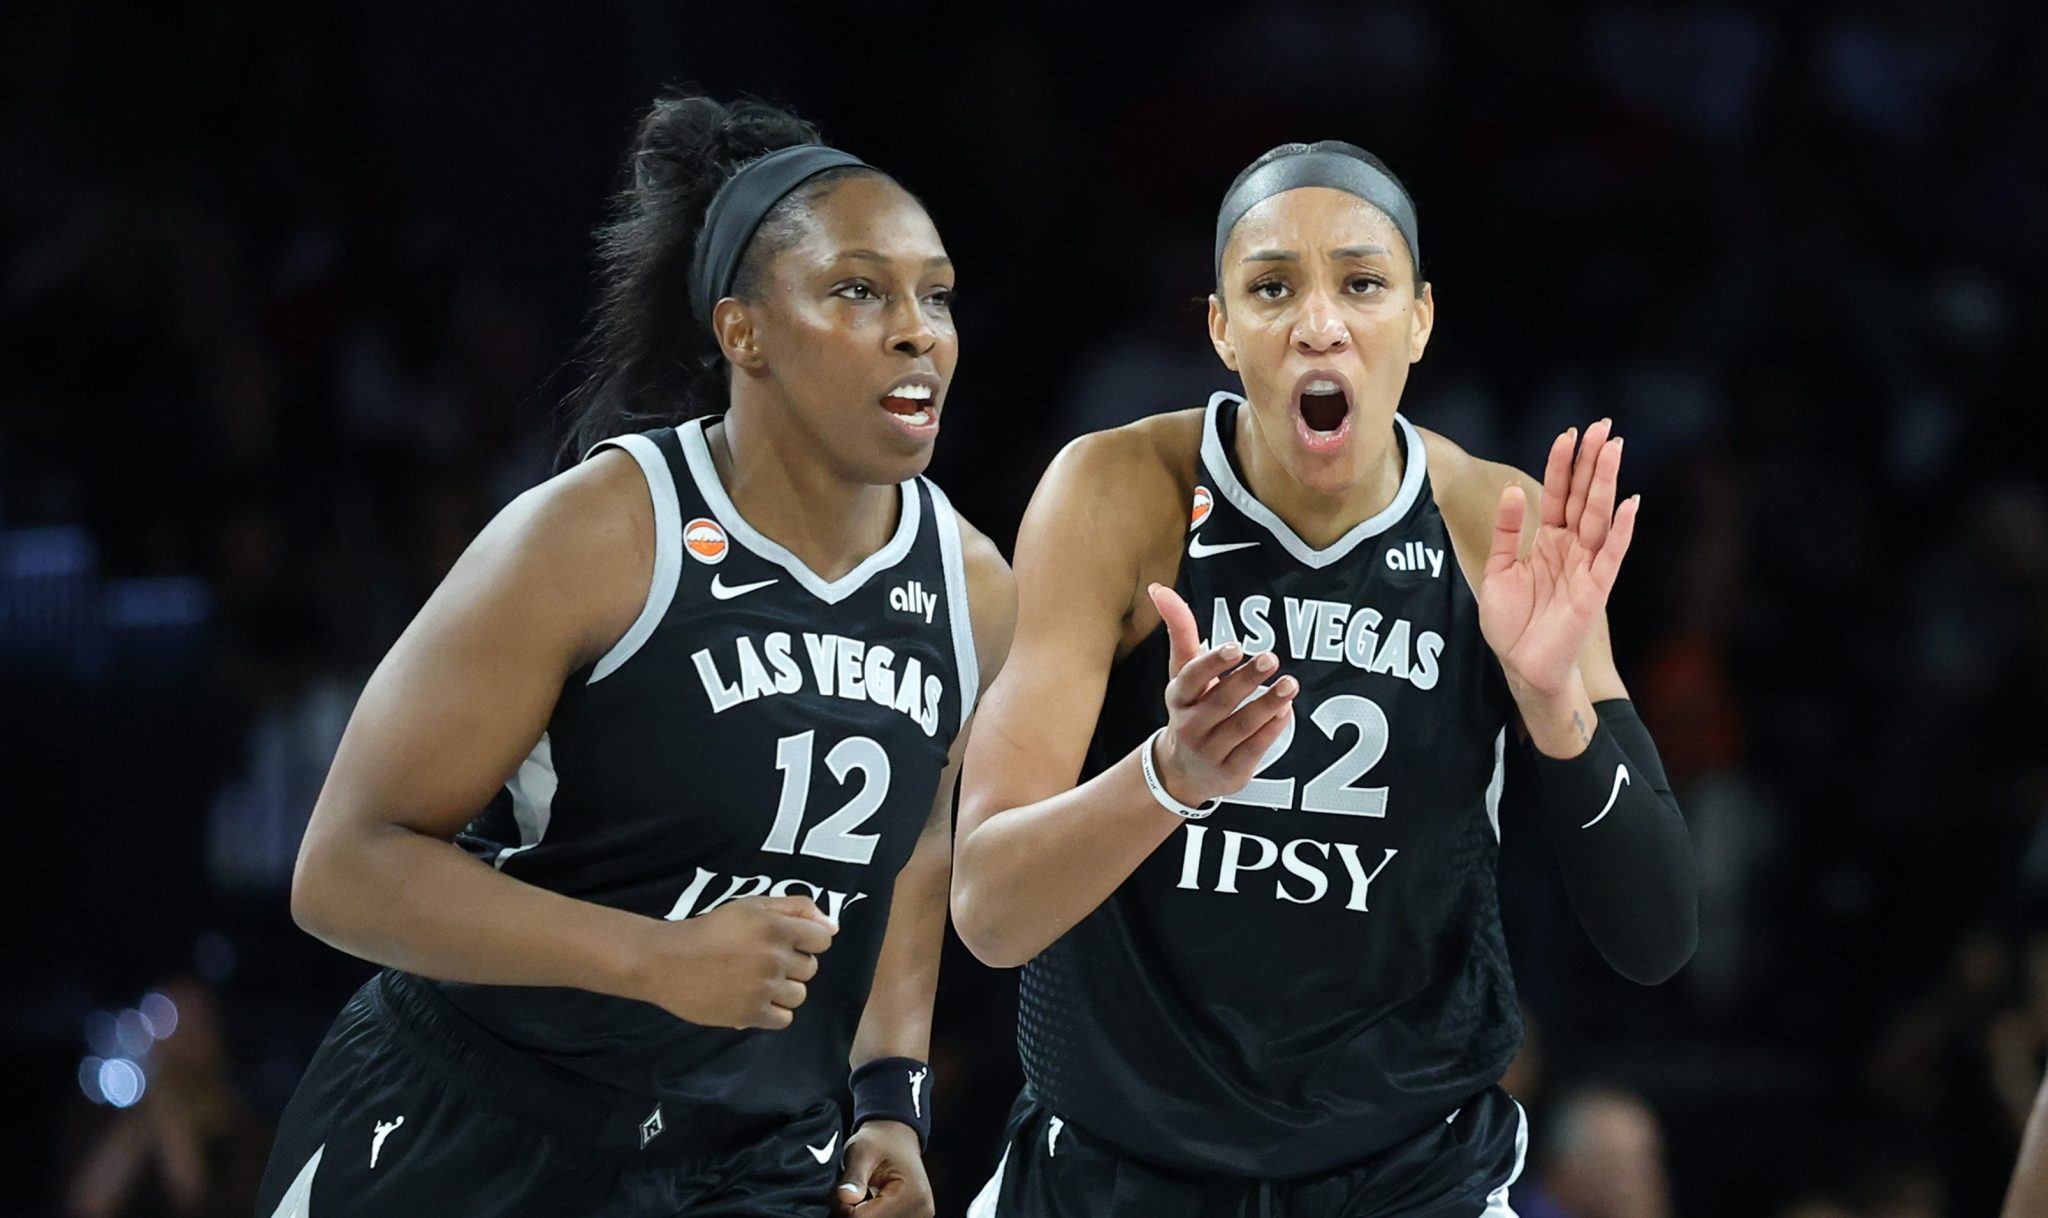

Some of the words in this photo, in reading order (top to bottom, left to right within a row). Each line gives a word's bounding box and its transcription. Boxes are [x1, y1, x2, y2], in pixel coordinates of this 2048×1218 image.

[889, 580, 937, 624] ally
[1385, 541, 1444, 578] ally
[691, 632, 803, 714] LAS
[803, 632, 943, 737] VEGAS
[1200, 595, 1276, 657] AS
[1284, 596, 1445, 691] VEGAS
[760, 729, 891, 865] 12
[1176, 823, 1399, 912] IPSY
